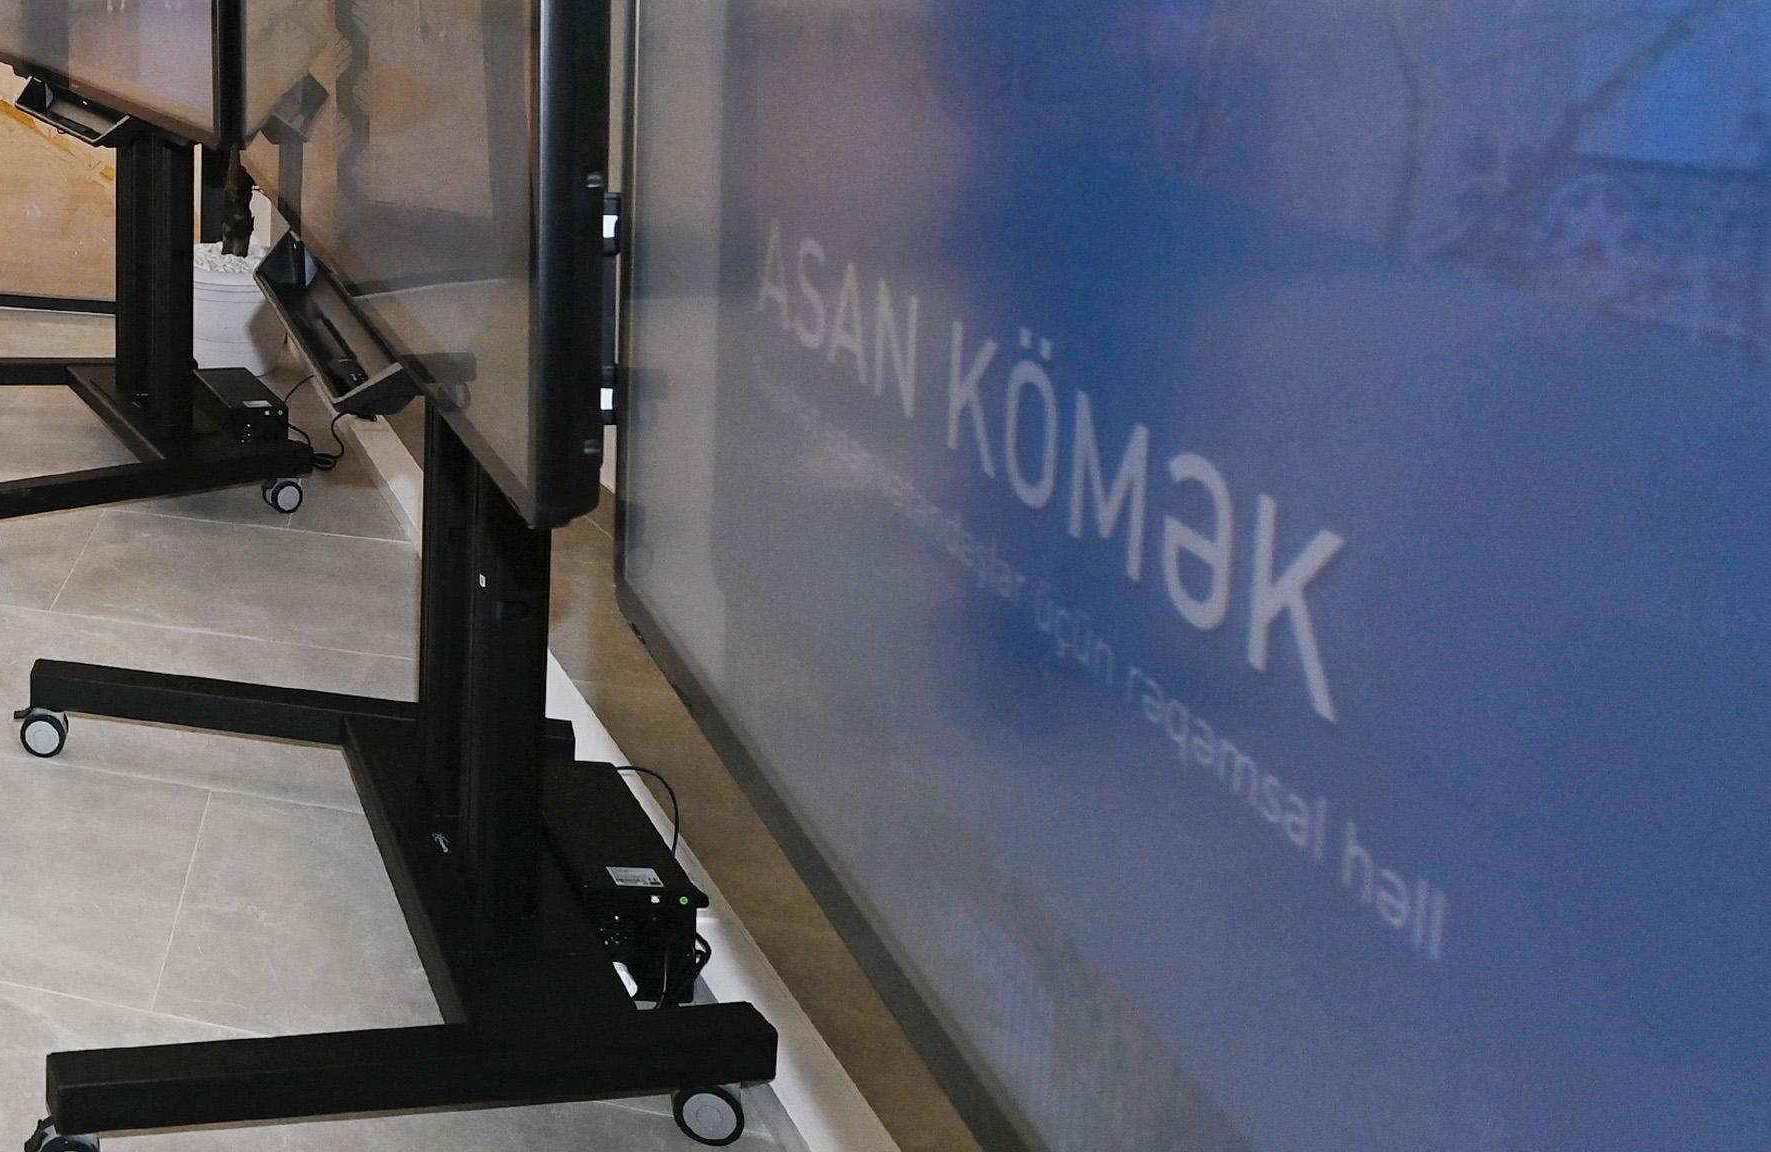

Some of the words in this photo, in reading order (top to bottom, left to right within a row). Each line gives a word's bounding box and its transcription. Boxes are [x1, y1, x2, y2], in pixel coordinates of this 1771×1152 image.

[755, 217, 919, 419] ASAN
[946, 320, 1346, 724] KÖMƏK
[1033, 580, 1115, 686] üçün
[1124, 664, 1329, 861] rəqəmsal
[1340, 818, 1447, 961] həll
